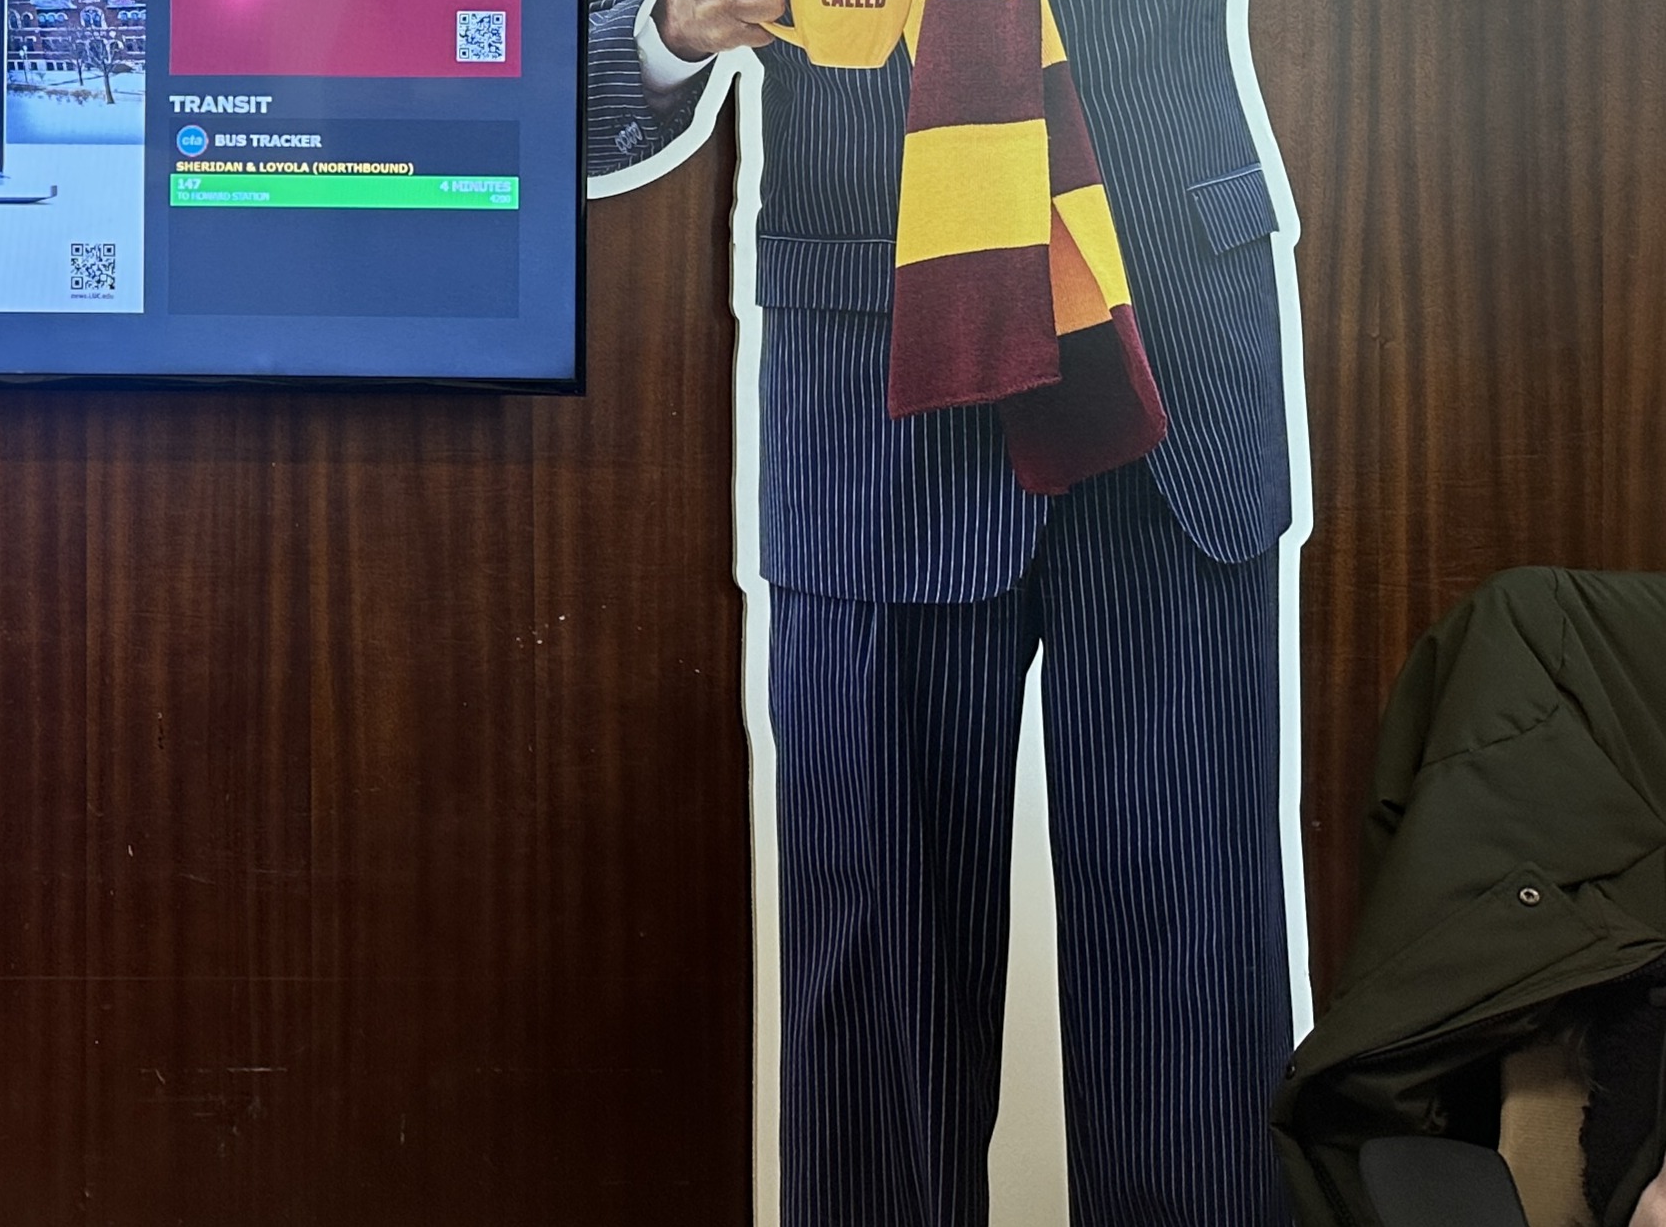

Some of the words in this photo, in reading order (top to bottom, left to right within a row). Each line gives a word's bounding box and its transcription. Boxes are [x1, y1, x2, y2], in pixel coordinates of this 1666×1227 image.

[169, 95, 272, 113] TRANSIT
[181, 134, 203, 146] cta
[215, 134, 247, 147] BUS
[250, 134, 322, 148] TRACKER
[176, 161, 243, 172] SHERIDAN
[246, 162, 256, 172] &
[259, 162, 309, 173] LOYOLA
[313, 162, 414, 175] (NORTHBOUND)
[177, 178, 201, 189] 147
[440, 180, 449, 192] 4
[452, 181, 511, 192] MINUTES
[178, 191, 190, 201] TO
[232, 191, 270, 201] STATION
